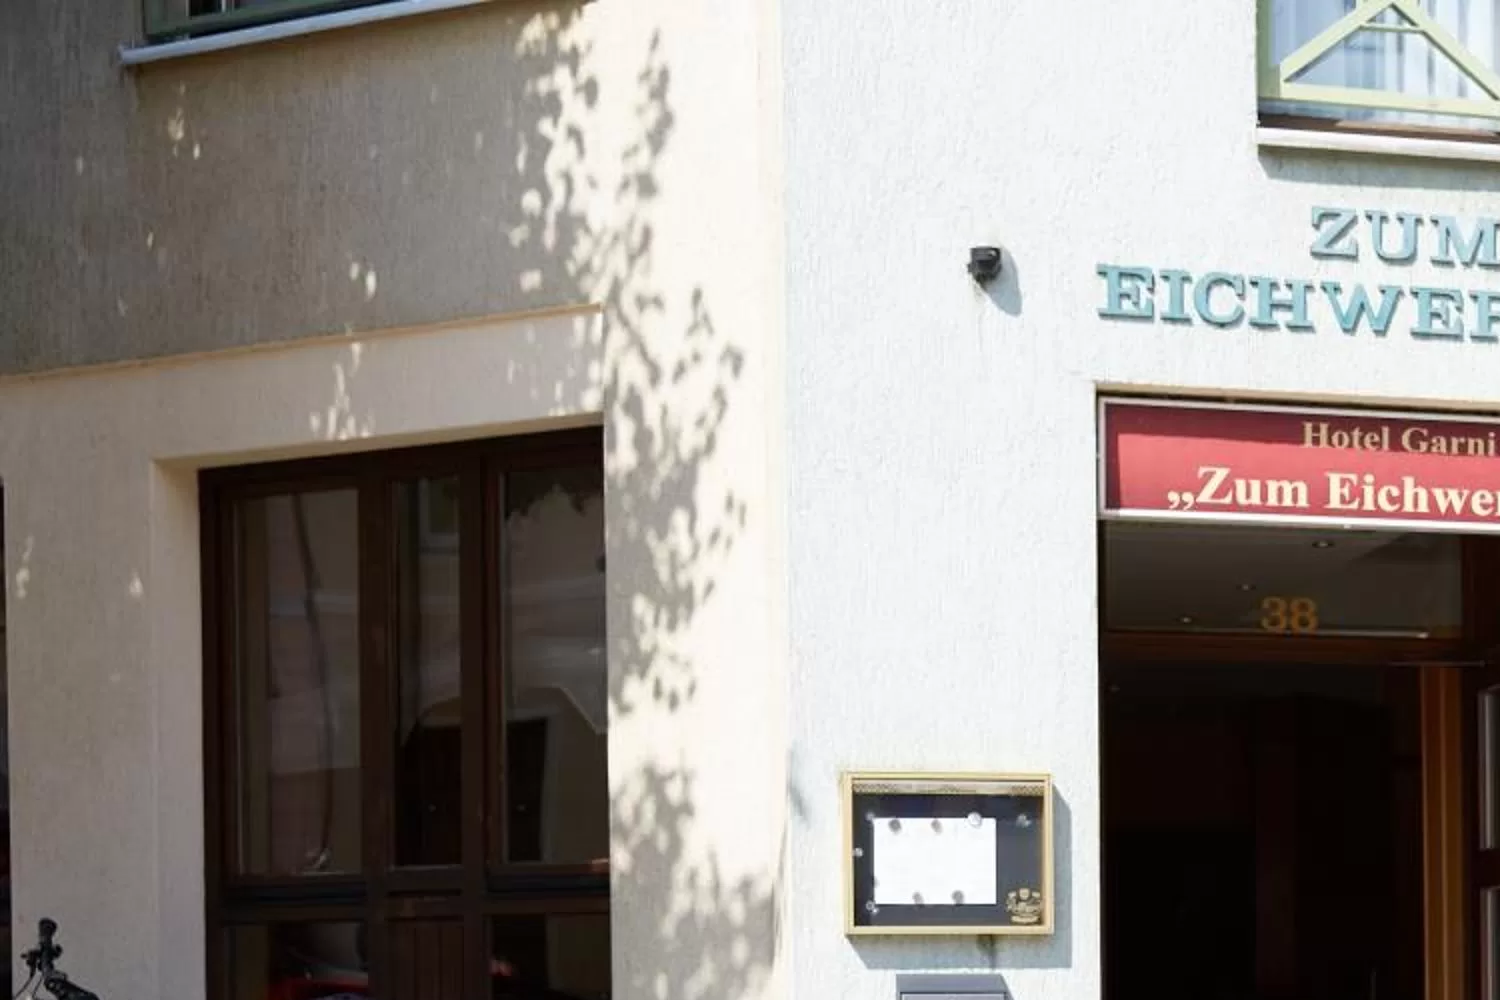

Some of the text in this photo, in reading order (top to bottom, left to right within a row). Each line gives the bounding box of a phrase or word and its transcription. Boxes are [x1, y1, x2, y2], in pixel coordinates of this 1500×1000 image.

[1301, 421, 1497, 458] Hotel Garni
[1260, 596, 1319, 633] 38
